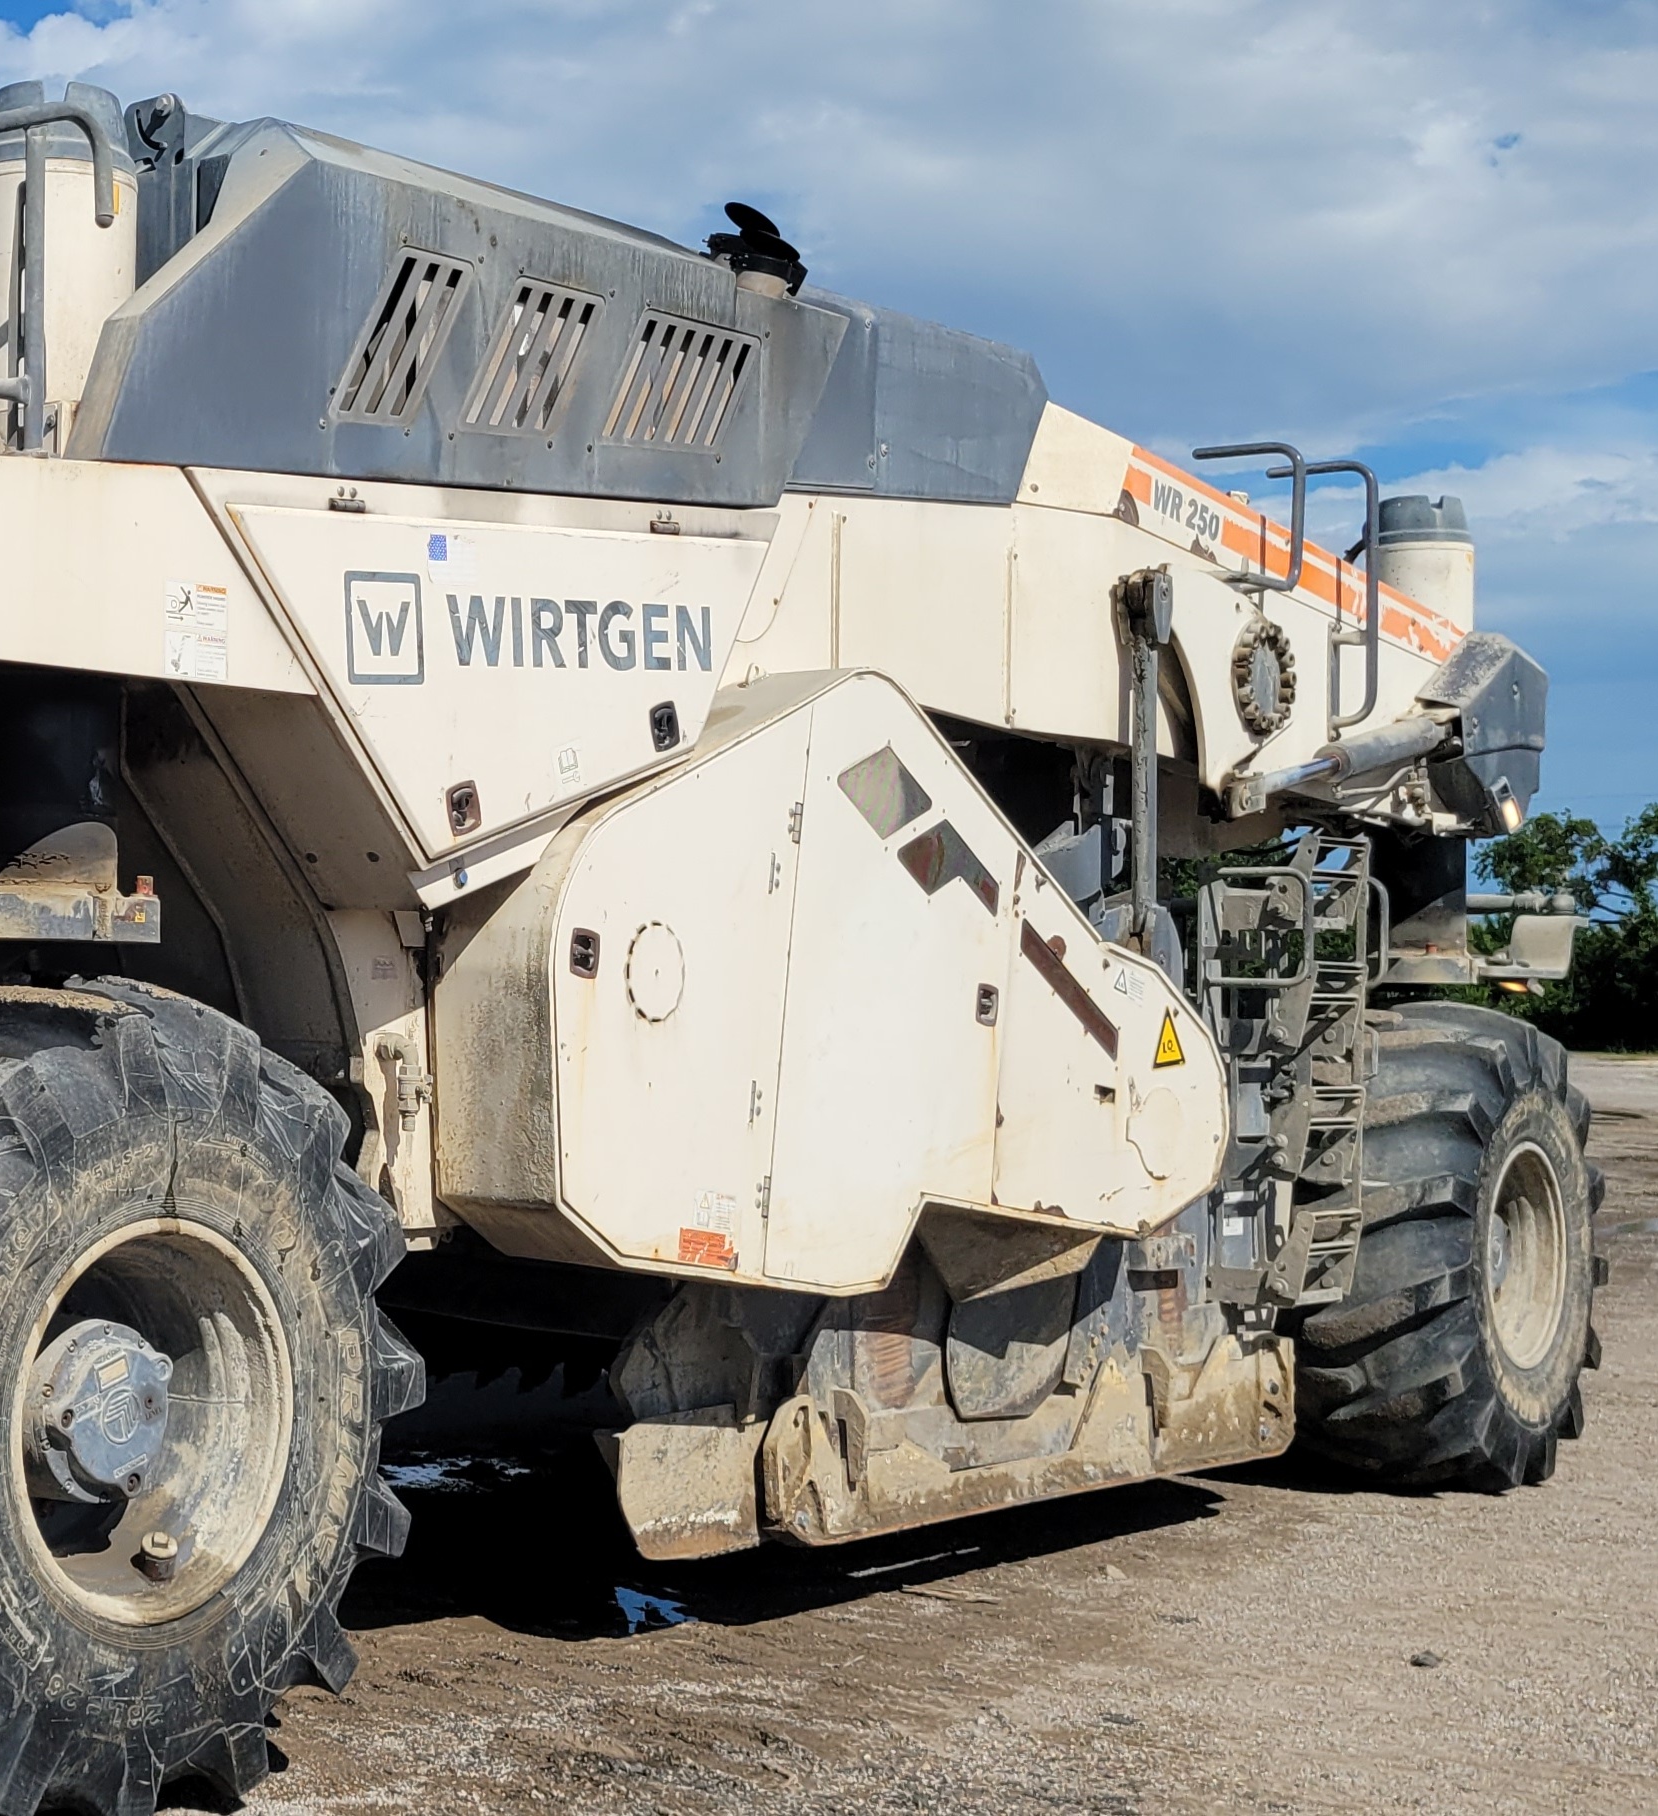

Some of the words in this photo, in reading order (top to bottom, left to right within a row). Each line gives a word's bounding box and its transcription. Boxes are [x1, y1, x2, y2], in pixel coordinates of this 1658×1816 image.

[1153, 479, 1183, 522] WR
[1185, 497, 1220, 542] 250
[445, 593, 713, 672] WIRTGEN
